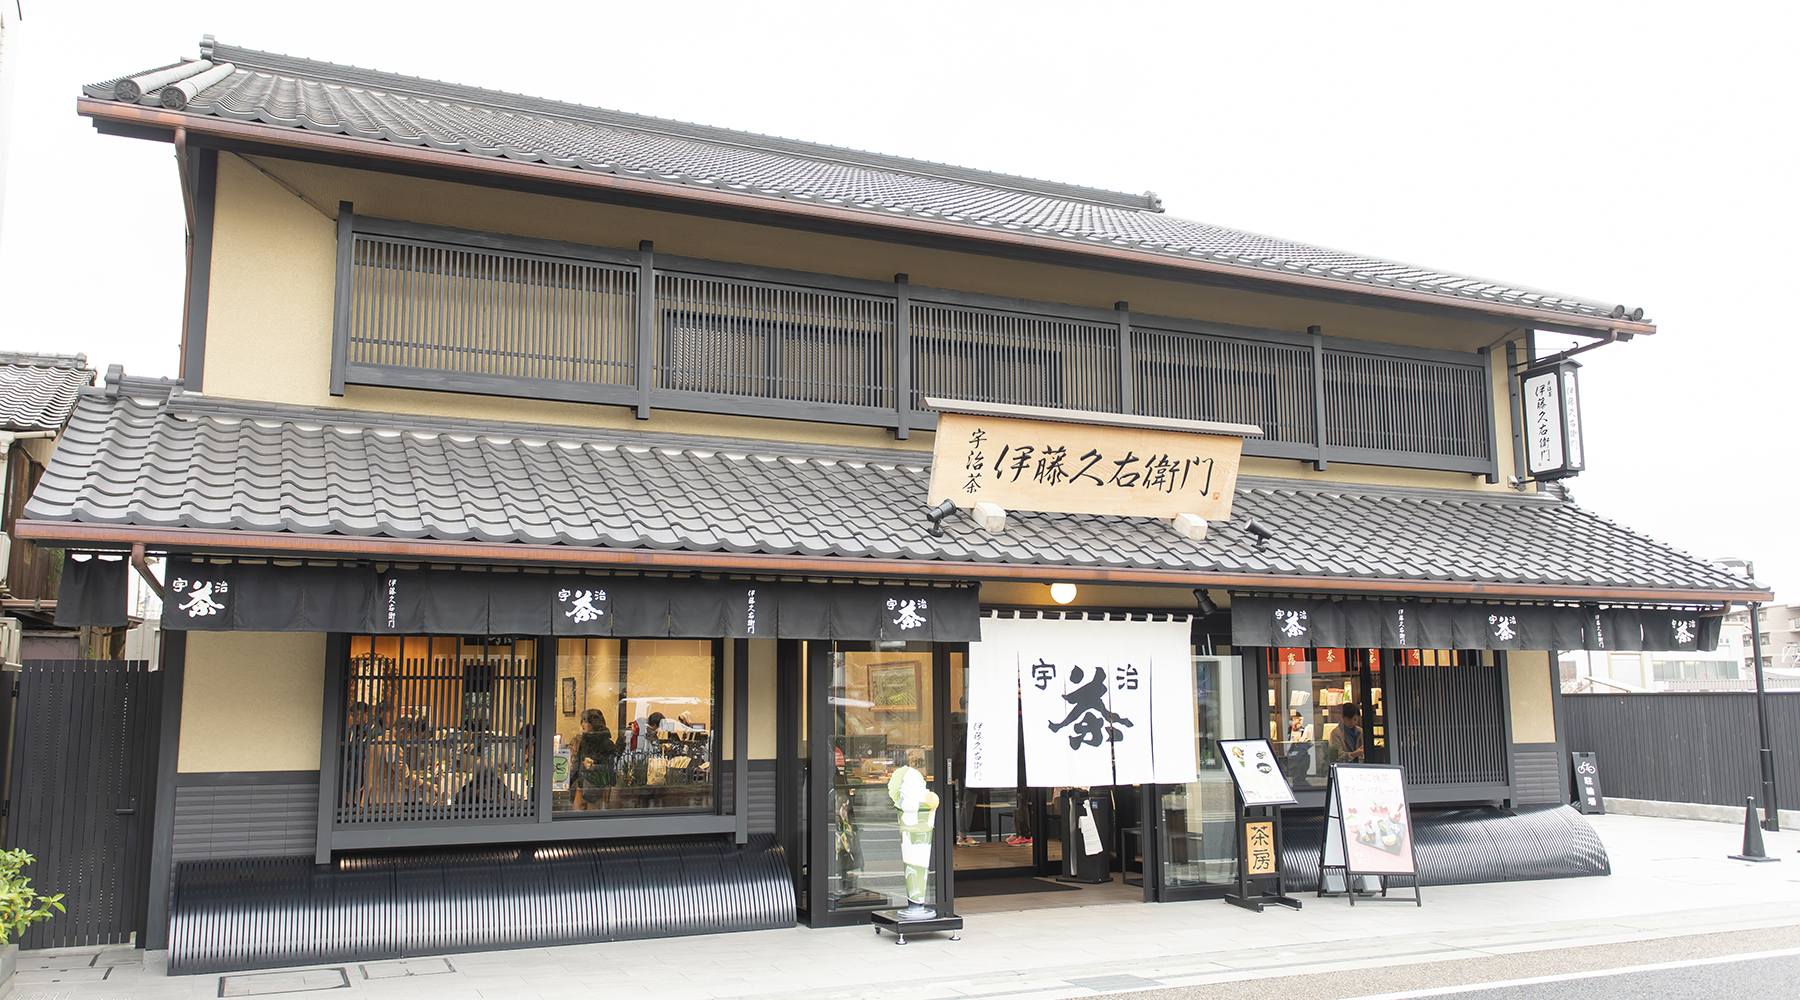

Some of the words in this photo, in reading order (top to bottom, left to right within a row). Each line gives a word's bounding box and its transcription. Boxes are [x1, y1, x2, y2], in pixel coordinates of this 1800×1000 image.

[1534, 384, 1550, 461] 伊藤久右衛門
[962, 428, 987, 493] 宇治茶
[993, 444, 1214, 496] 伊藤久右衛門
[1251, 826, 1270, 870] 茶房
